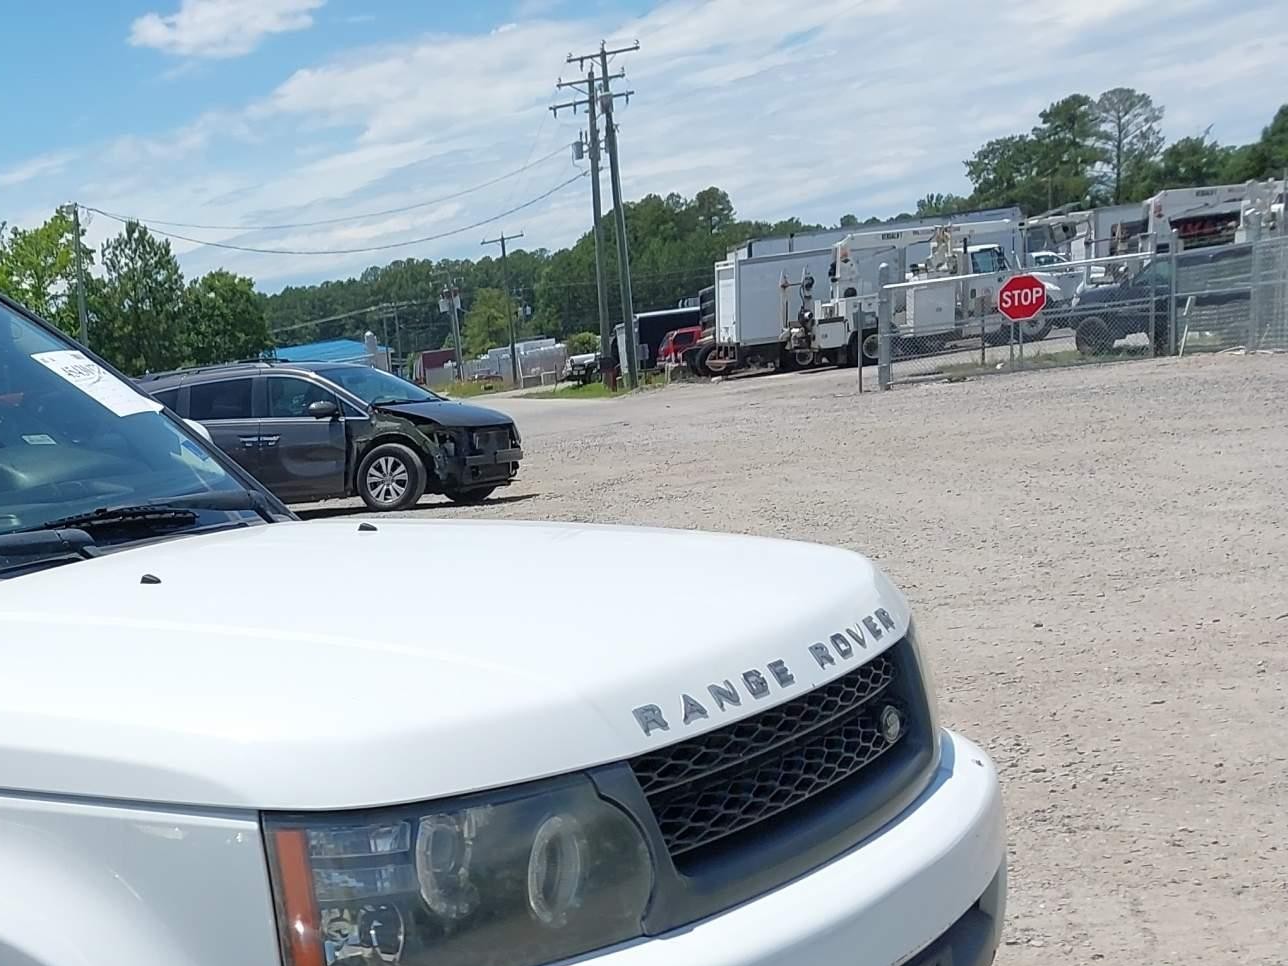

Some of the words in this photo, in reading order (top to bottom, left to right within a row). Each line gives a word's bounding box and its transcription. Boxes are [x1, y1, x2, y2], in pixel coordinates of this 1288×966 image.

[1001, 287, 1043, 308] STOP
[631, 658, 796, 737] RANGE
[808, 607, 896, 670] ROVER
